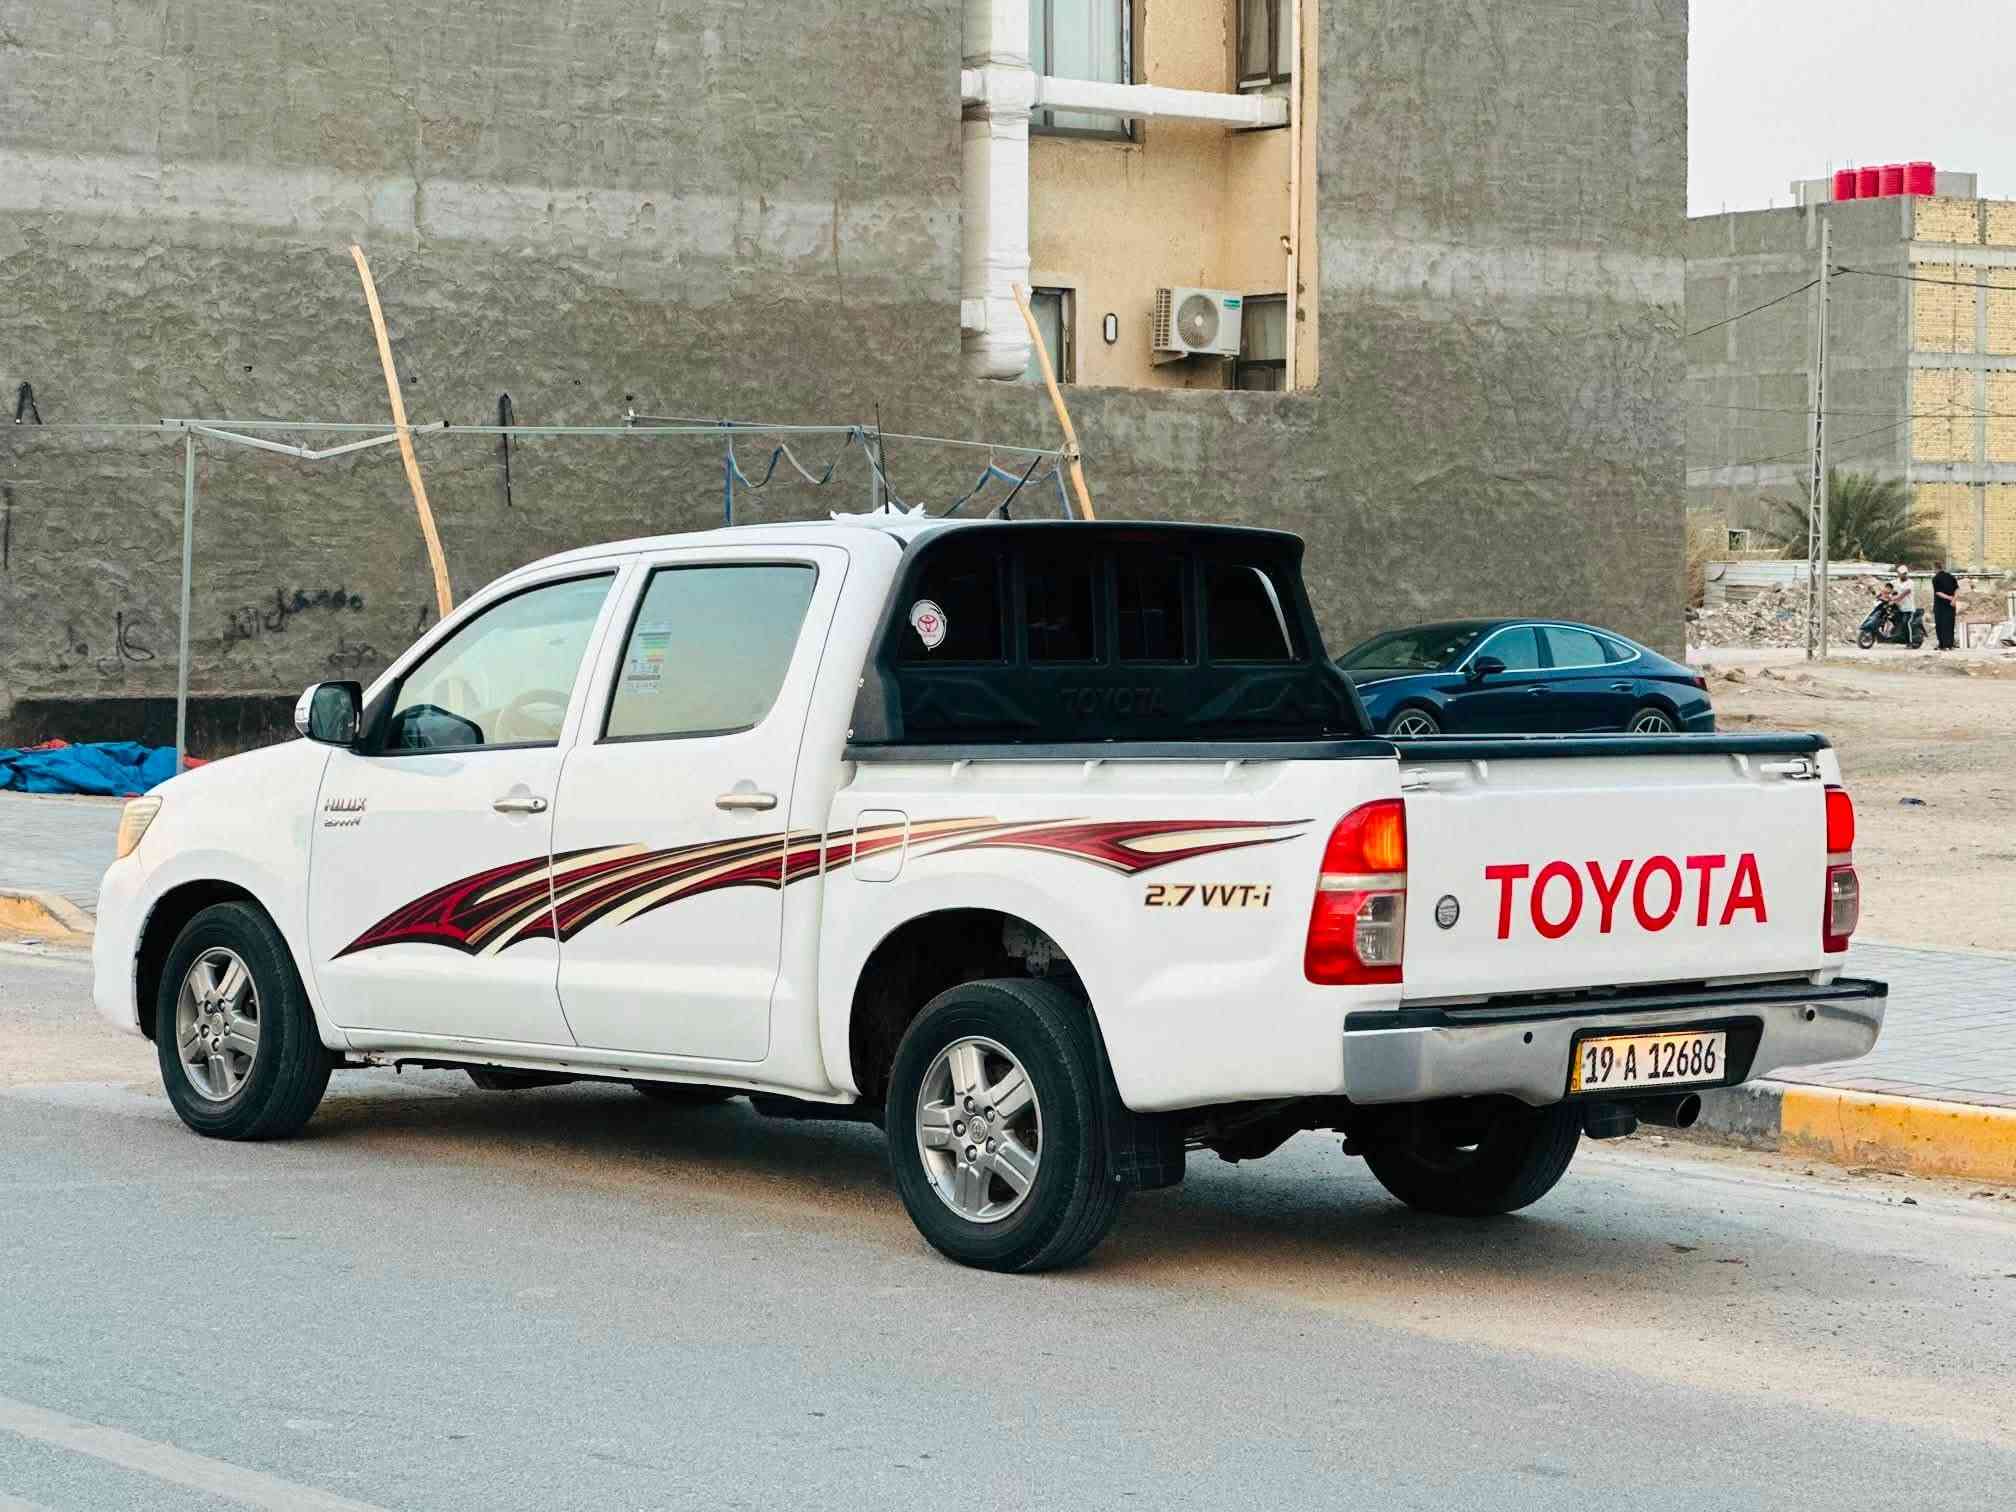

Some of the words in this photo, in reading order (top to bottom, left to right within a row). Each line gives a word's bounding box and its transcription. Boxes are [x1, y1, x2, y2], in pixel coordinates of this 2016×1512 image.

[1143, 884, 1196, 907] 2.7
[1200, 884, 1272, 907] VVT-i
[1485, 853, 1768, 940] TOYOTA
[1585, 1046, 1614, 1083] 19
[1623, 1043, 1637, 1081] A
[1647, 1038, 1716, 1079] 12686
